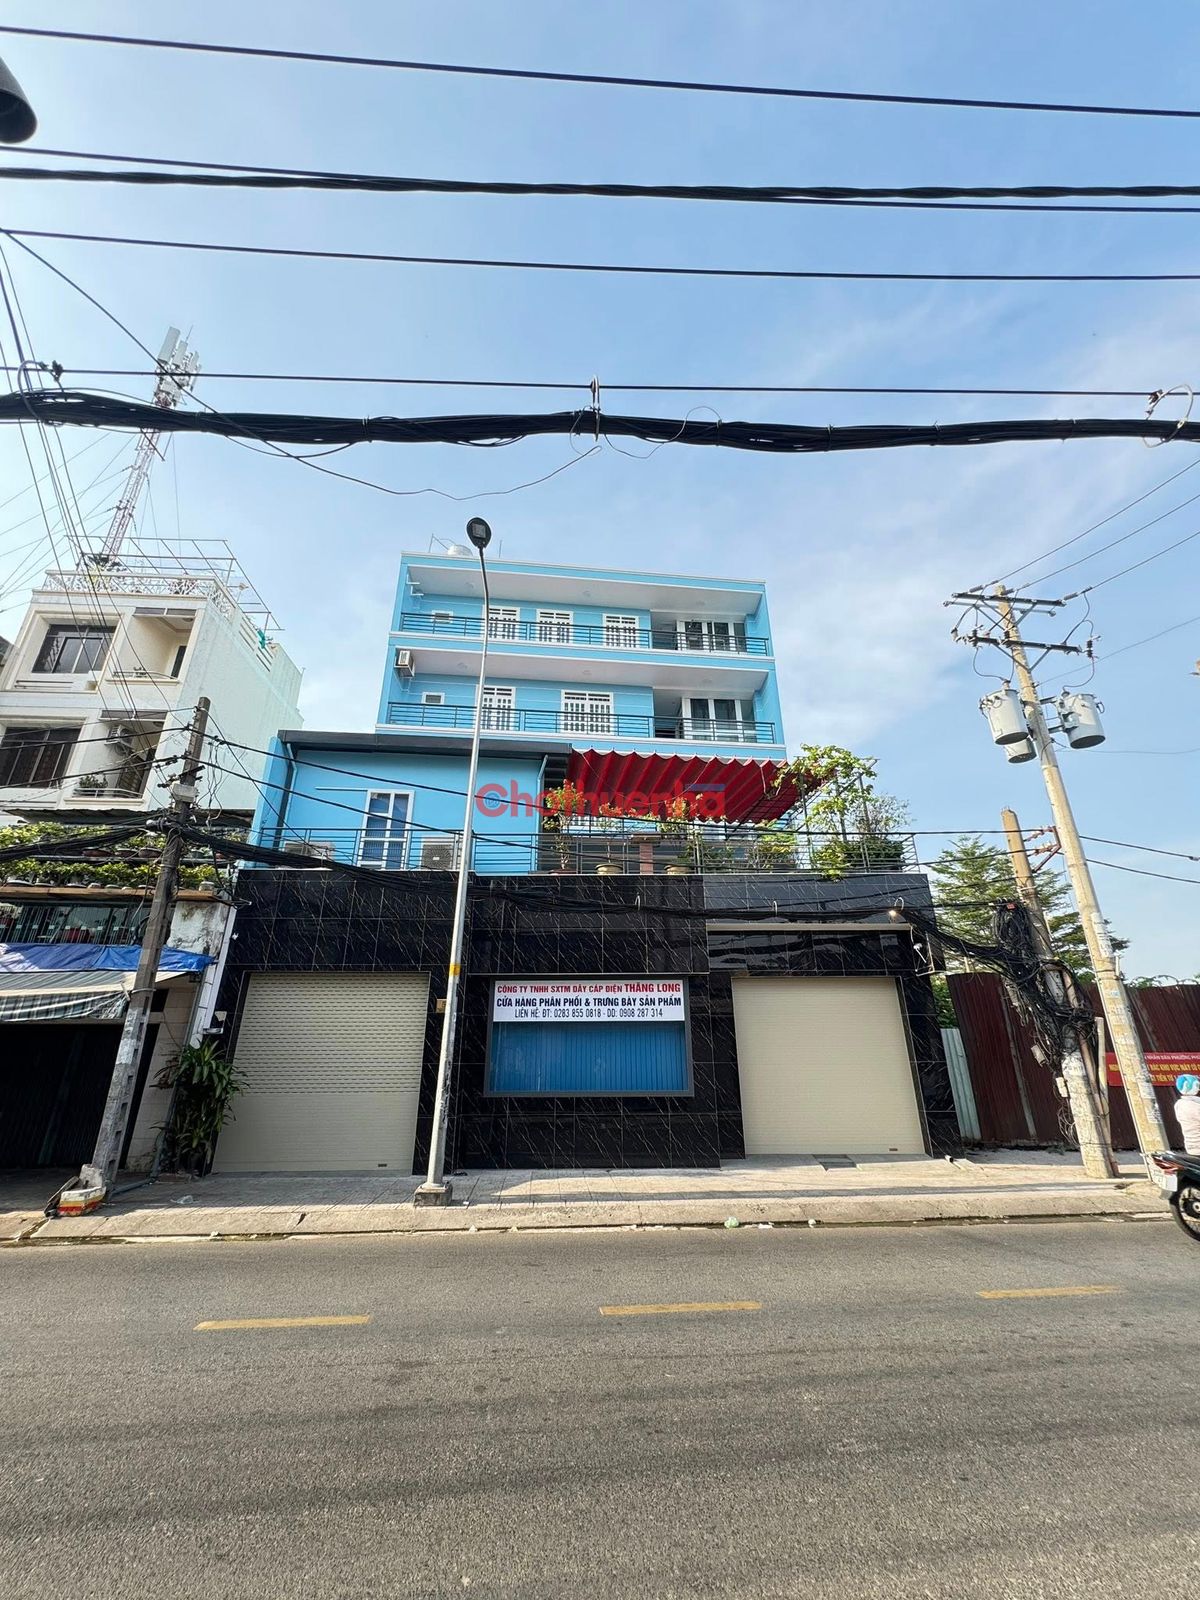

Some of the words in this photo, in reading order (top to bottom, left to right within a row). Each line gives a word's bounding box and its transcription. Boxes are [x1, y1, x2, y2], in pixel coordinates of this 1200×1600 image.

[497, 983, 518, 993] CÔNG
[519, 985, 529, 993] TY
[530, 985, 549, 993] TNHH
[550, 985, 571, 993] SXTM
[572, 983, 587, 993] DÂY
[605, 983, 623, 994] ĐIỆN
[657, 984, 681, 993] LONG
[496, 995, 513, 1007] CỬA
[514, 996, 537, 1007] HÀNG
[539, 996, 561, 1007] PHÂN
[563, 994, 582, 1007] PHỐI
[584, 997, 591, 1007] &
[592, 996, 619, 1007] TRƯNG
[621, 995, 637, 1007] BÀY
[639, 994, 656, 1007] SẢN
[657, 993, 682, 1006] PHẨM
[553, 1008, 570, 1018] 0283
[571, 1008, 584, 1018] 855
[585, 1008, 602, 1018] 0818
[619, 1008, 636, 1018] 0908
[636, 1008, 649, 1018] 287
[650, 1008, 663, 1018] 314
